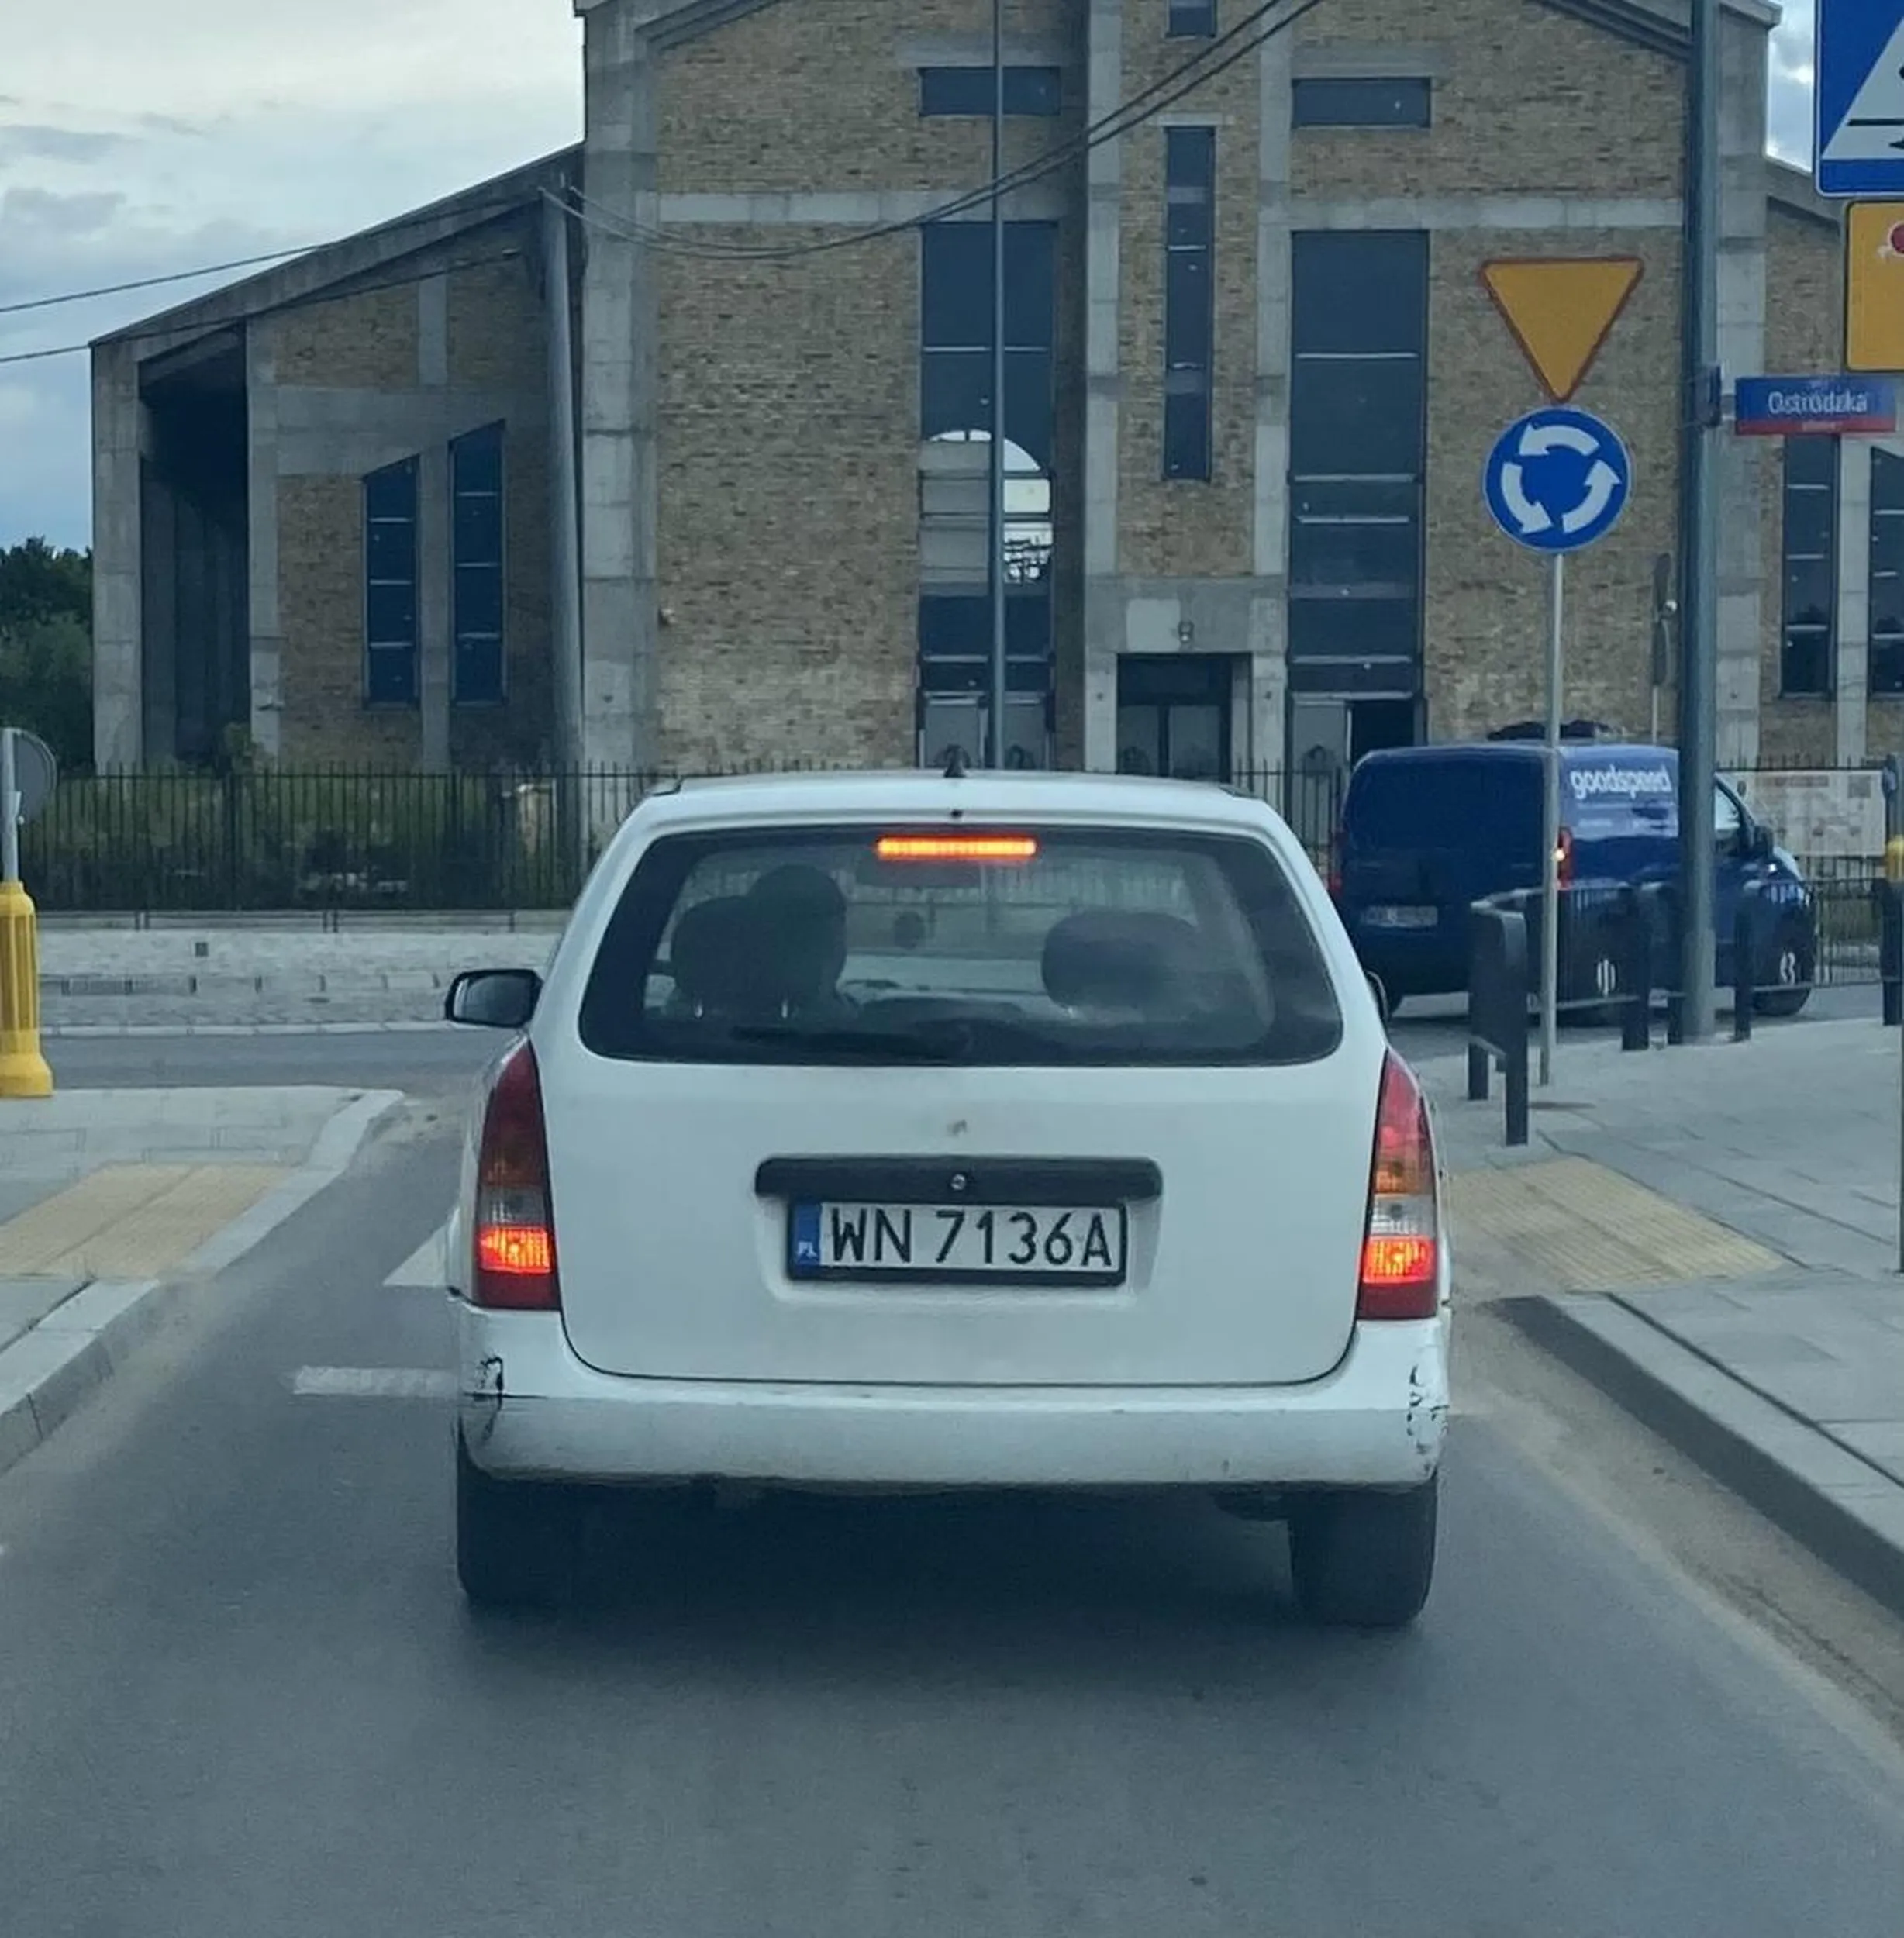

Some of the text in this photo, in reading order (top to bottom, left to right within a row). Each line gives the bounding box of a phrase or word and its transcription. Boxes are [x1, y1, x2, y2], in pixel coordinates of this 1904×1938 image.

[1570, 764, 1672, 799] goodspeed
[798, 1241, 817, 1258] PL
[830, 1207, 1112, 1267] WN 7136A
